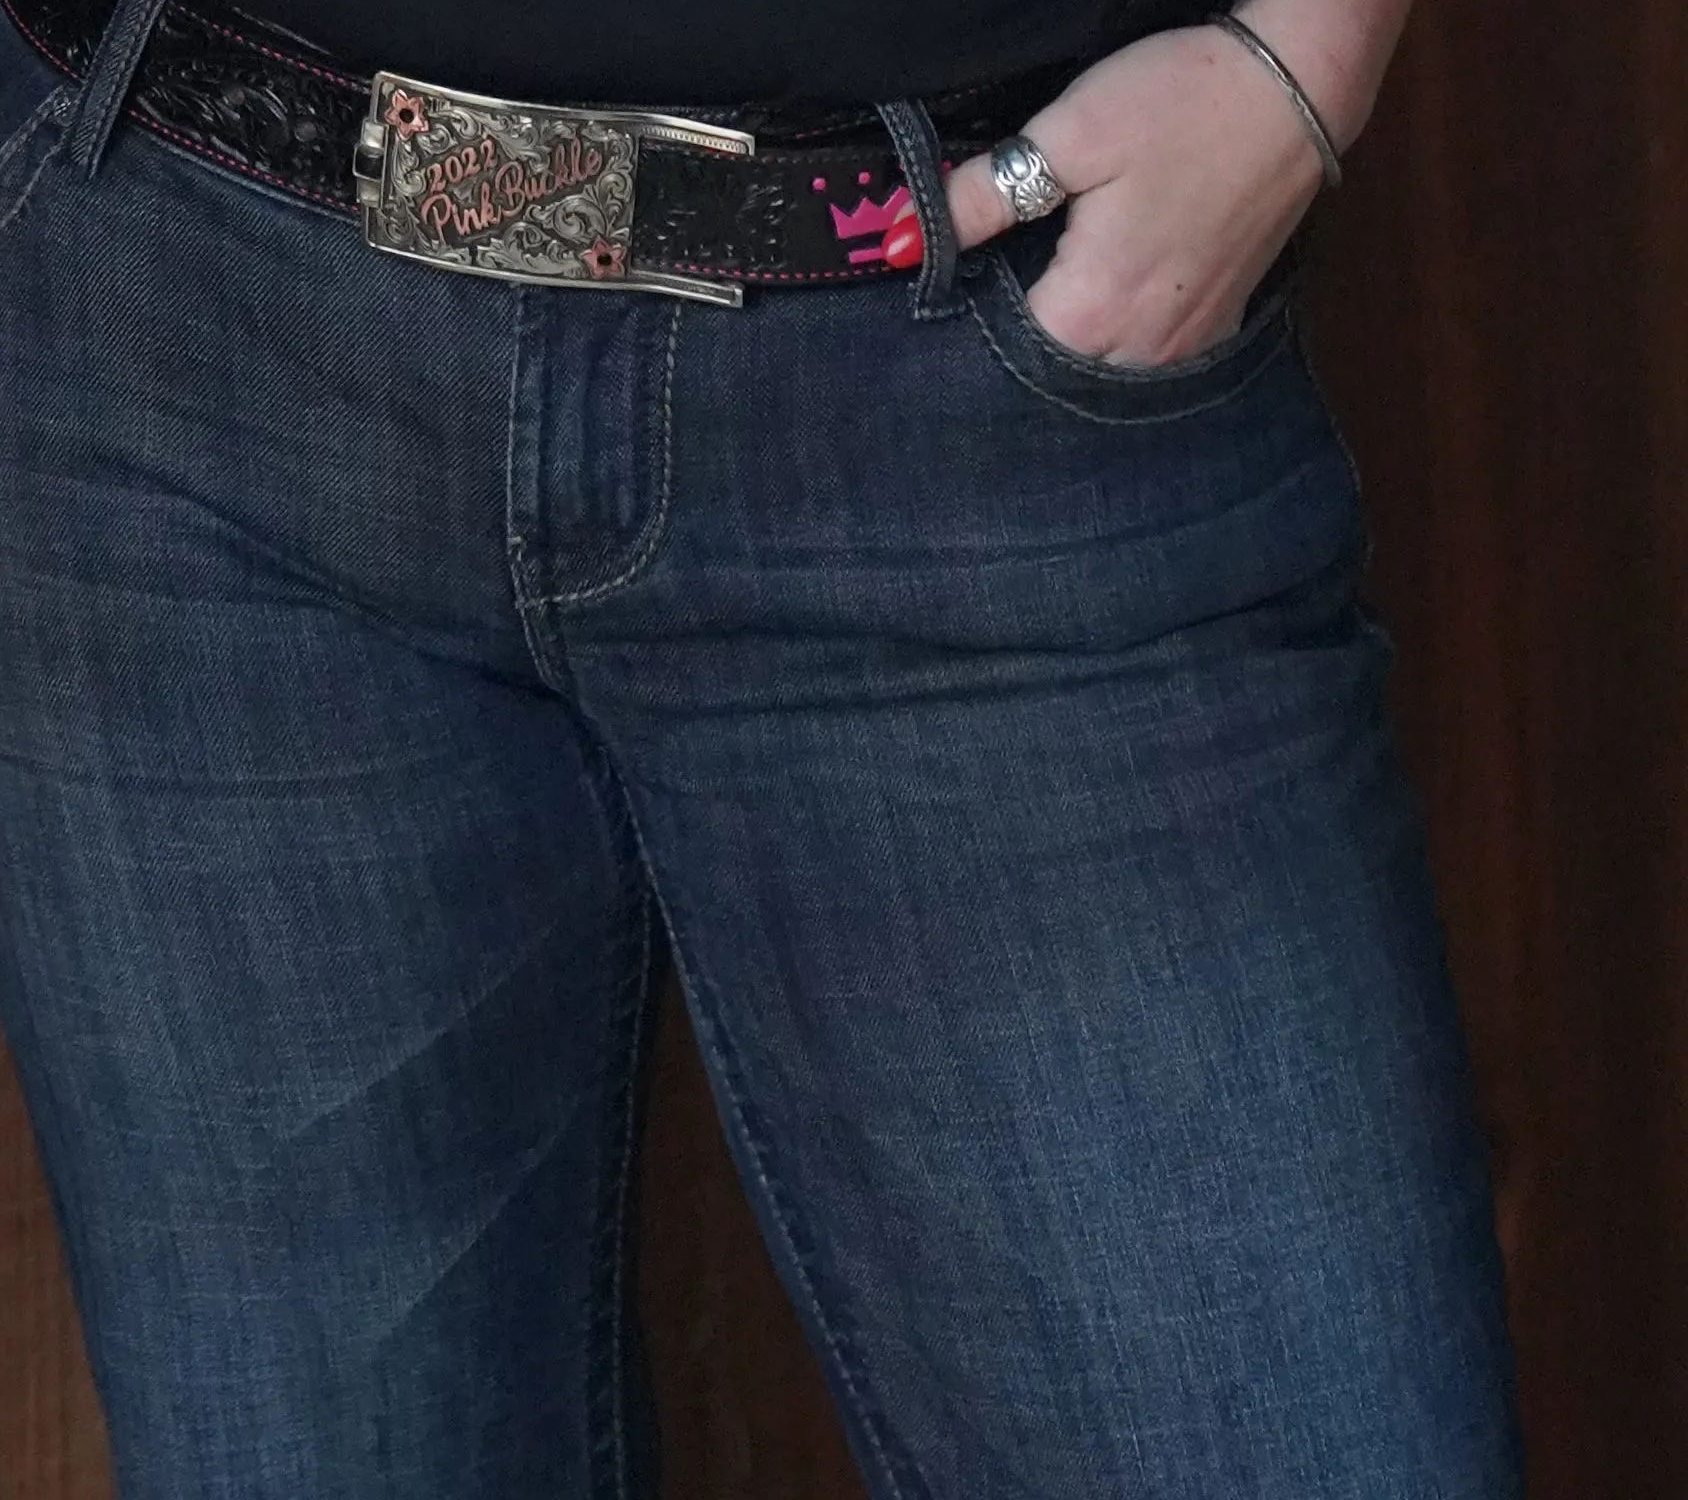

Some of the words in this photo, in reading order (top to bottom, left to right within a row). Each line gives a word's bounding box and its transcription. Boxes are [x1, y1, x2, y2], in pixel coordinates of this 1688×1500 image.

[421, 183, 501, 241] Pink
[496, 137, 603, 217] Buckle
[428, 138, 496, 195] 2022
